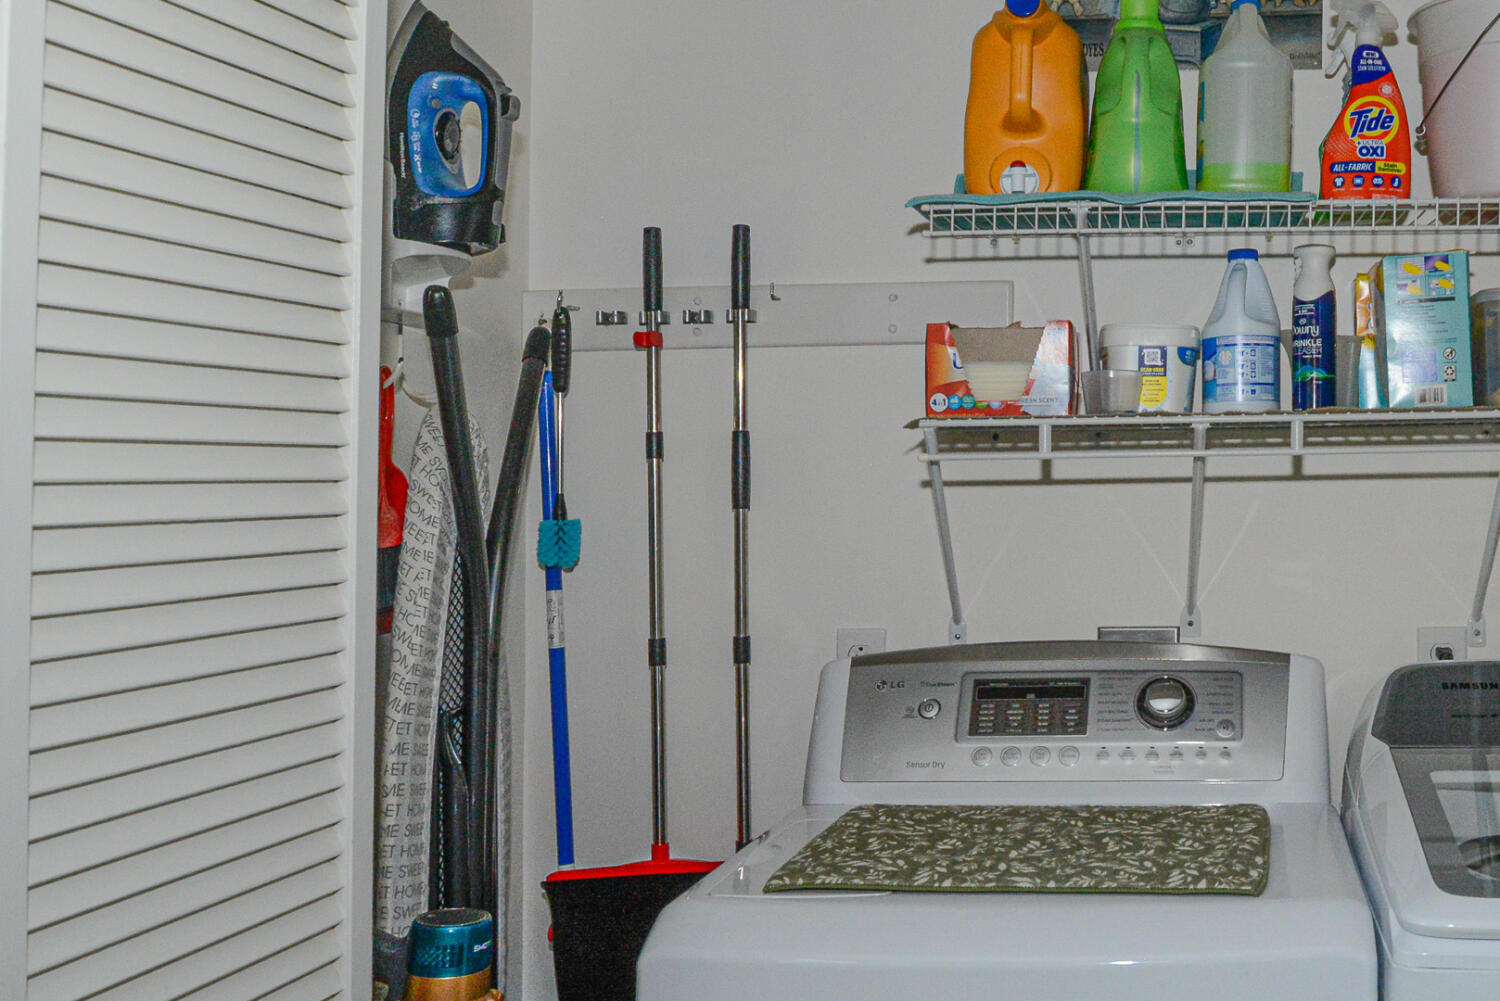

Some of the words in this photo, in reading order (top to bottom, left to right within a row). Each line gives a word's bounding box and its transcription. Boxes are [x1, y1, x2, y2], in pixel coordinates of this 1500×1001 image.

[1349, 107, 1395, 139] Tide
[1357, 145, 1385, 158] OXI
[1333, 162, 1373, 172] ALL-FABRIC
[1294, 338, 1322, 347] RINKLE
[890, 681, 905, 689] LG
[906, 761, 930, 769] Sensor
[932, 761, 946, 769] Dry
